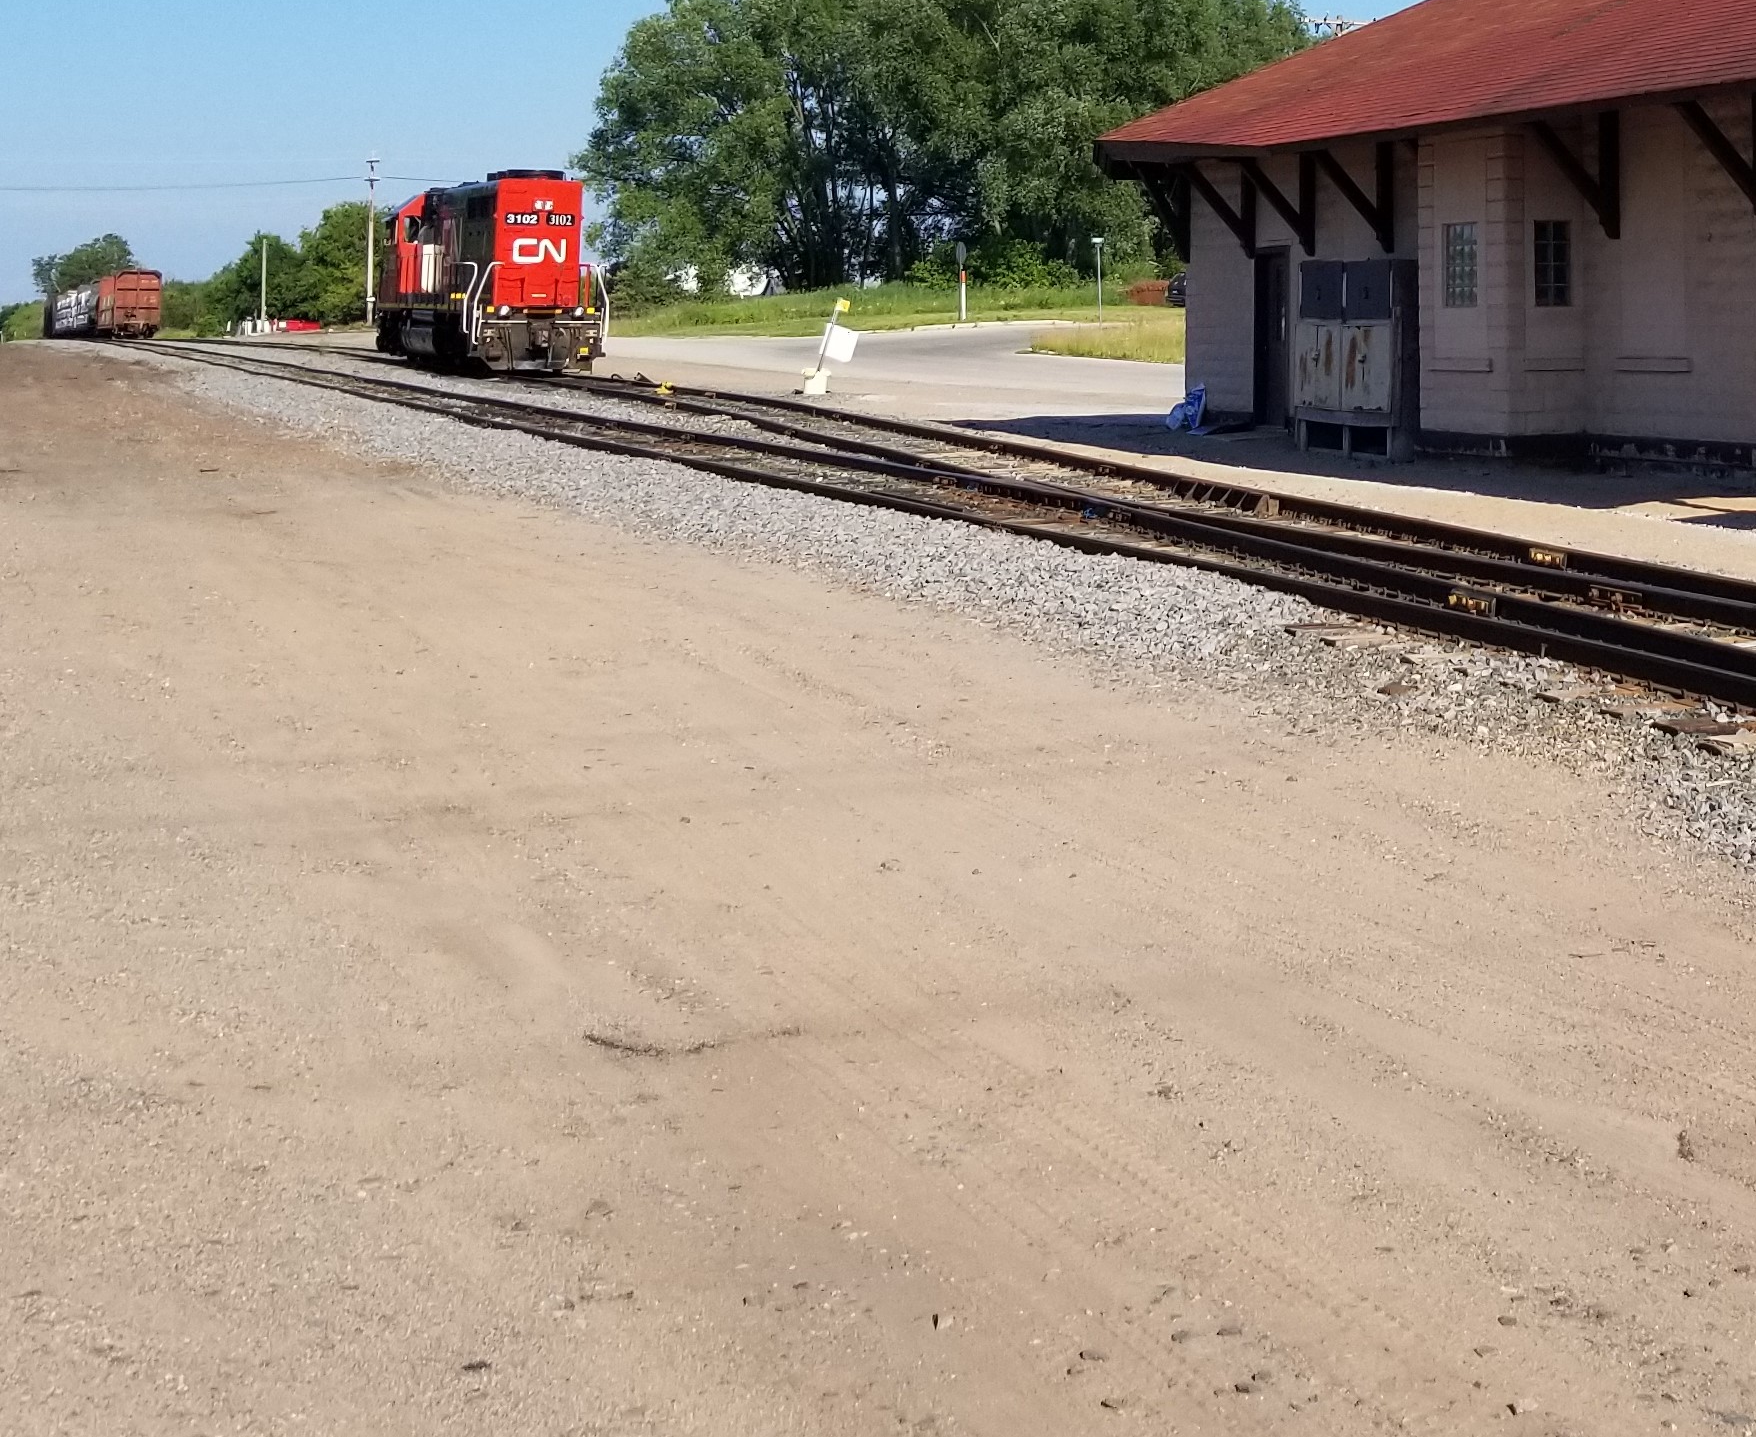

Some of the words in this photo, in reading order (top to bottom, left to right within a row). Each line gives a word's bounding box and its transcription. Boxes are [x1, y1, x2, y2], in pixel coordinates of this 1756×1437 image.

[506, 213, 538, 224] 3102
[549, 214, 573, 226] 3102
[512, 238, 567, 263] CN
